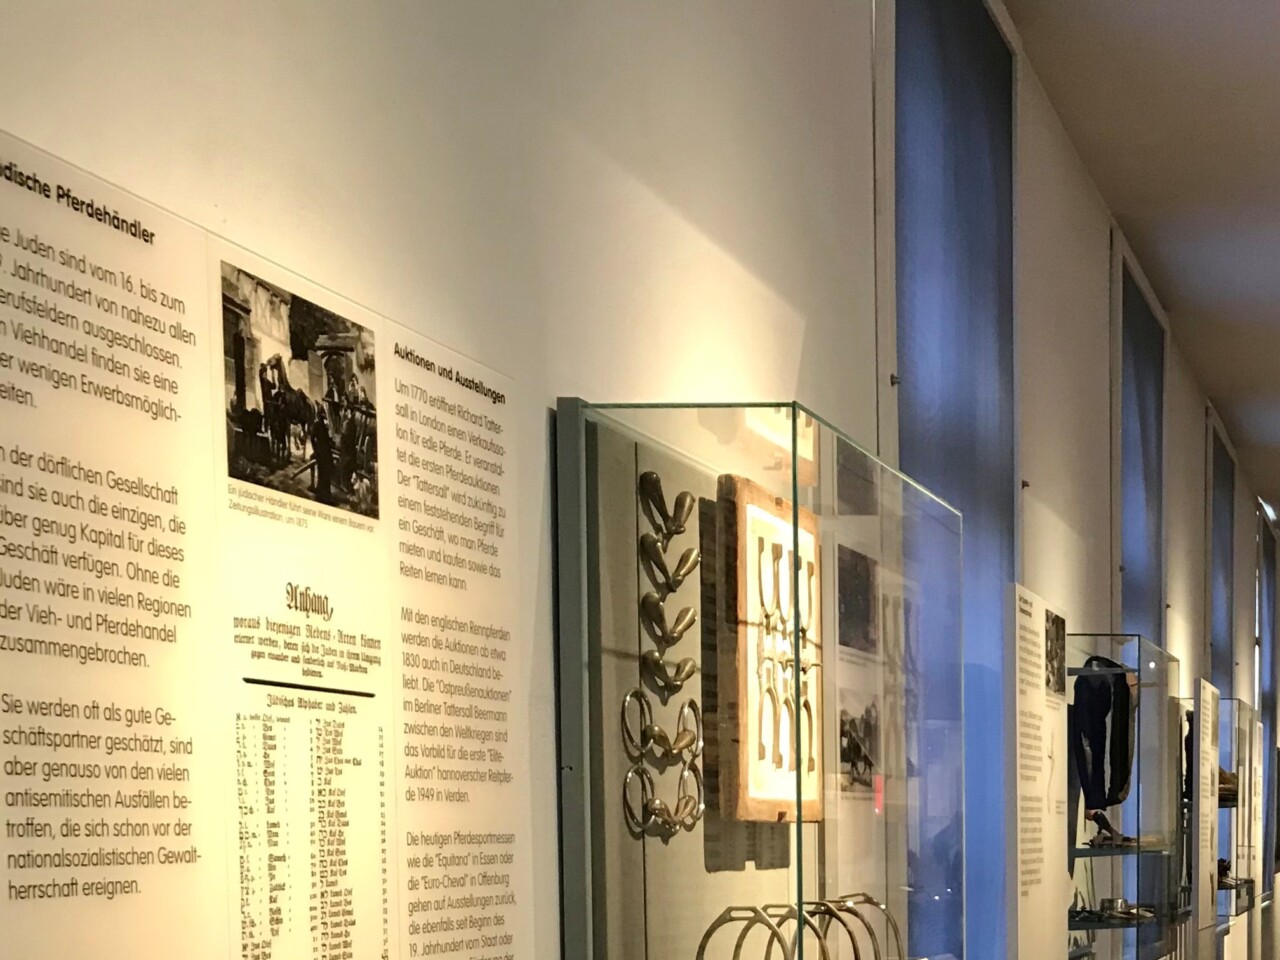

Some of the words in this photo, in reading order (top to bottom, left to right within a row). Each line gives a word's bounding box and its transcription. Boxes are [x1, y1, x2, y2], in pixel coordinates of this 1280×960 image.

[56, 184, 155, 243] Pferdehändler
[14, 228, 55, 261] Juden
[58, 248, 86, 273] sind
[89, 262, 116, 286] vom
[121, 271, 135, 294] 16.
[139, 278, 157, 303] bis
[160, 292, 185, 314] zum
[11, 259, 92, 305] Jahrhundert
[94, 294, 118, 316] von
[121, 305, 166, 334] nahezu
[168, 321, 196, 346] allen
[10, 319, 87, 362] Viehhandel
[91, 346, 130, 378] finden
[133, 364, 150, 385] sie
[152, 372, 178, 394] eine
[82, 320, 181, 367] ausgeschlossen.
[17, 358, 77, 389] wenigen
[80, 374, 180, 420] Erwerbsmöglich-
[393, 342, 436, 372] Auktionen
[437, 365, 453, 380] und
[454, 370, 505, 404] Ausstellungen
[394, 377, 409, 396] Um
[410, 383, 428, 403] 1770
[457, 404, 482, 426] Richard
[9, 444, 32, 468] der
[36, 452, 102, 485] dörflichen
[106, 470, 177, 504] Gesellschaft
[397, 469, 410, 486] Der
[450, 490, 466, 505] wird
[498, 506, 506, 518] zu
[27, 481, 47, 502] sie
[50, 489, 84, 511] auch
[88, 494, 108, 516] die
[110, 502, 165, 532] einzigen,
[168, 514, 186, 534] die
[31, 516, 76, 544] genug
[79, 522, 124, 549] Kapital
[127, 531, 144, 552] für
[146, 537, 184, 561] dieses
[398, 516, 410, 531] ein
[412, 519, 446, 543] Geschäft,
[447, 533, 459, 545] wo
[460, 536, 476, 550] man
[477, 538, 498, 556] Pferde
[61, 551, 122, 578] verfügen.
[126, 561, 159, 584] Ohne
[162, 568, 180, 588] die
[398, 540, 425, 557] mieten
[426, 548, 441, 562] und
[442, 549, 467, 568] kaufen
[468, 559, 488, 574] sowie
[488, 562, 501, 577] das
[400, 560, 423, 579] Reiten
[424, 566, 447, 585] lernen
[43, 577, 79, 599] wäre
[82, 581, 94, 602] in
[97, 586, 134, 608] vielen
[137, 591, 191, 617] Regionen
[0, 598, 22, 620] der
[25, 603, 62, 625] Vieh-
[66, 611, 92, 631] und
[95, 613, 176, 642] Pferdehandel
[0, 635, 149, 666] zusammengebrochen.
[402, 651, 420, 667] 1830
[421, 656, 440, 670] auch
[441, 658, 448, 672] in
[449, 659, 491, 678] Deutschland
[1, 692, 23, 714] Sie
[26, 697, 79, 718] werden
[83, 699, 99, 719] oft
[102, 701, 121, 721] als
[124, 706, 152, 727] gute
[154, 706, 175, 725] Ge-
[2, 725, 101, 751] schäftspartner
[104, 733, 166, 755] geschätzt,
[169, 736, 192, 754] sind
[3, 754, 36, 776] aber
[41, 762, 101, 782] genauso
[104, 764, 127, 779] von
[130, 760, 154, 780] den
[156, 762, 189, 781] vielen
[4, 787, 111, 807] antisemitischen
[114, 789, 170, 808] Ausfällen
[172, 789, 191, 808] be-
[405, 785, 415, 801] de
[417, 786, 434, 801] 1949
[436, 787, 443, 801] in
[444, 787, 470, 802] Verden.
[6, 816, 55, 840] troffen,
[59, 817, 80, 837] die
[84, 817, 109, 837] sich
[112, 817, 149, 836] schon
[152, 822, 170, 836] vor
[173, 817, 191, 836] der
[7, 847, 154, 868] nationalsozialistischen
[156, 845, 200, 864] Gewalt-
[406, 854, 420, 868] wie
[422, 852, 434, 867] die
[472, 852, 478, 865] in
[479, 851, 498, 865] Essen
[499, 850, 513, 864] oder
[8, 877, 78, 899] herrschaft
[82, 877, 140, 899] ereignen.
